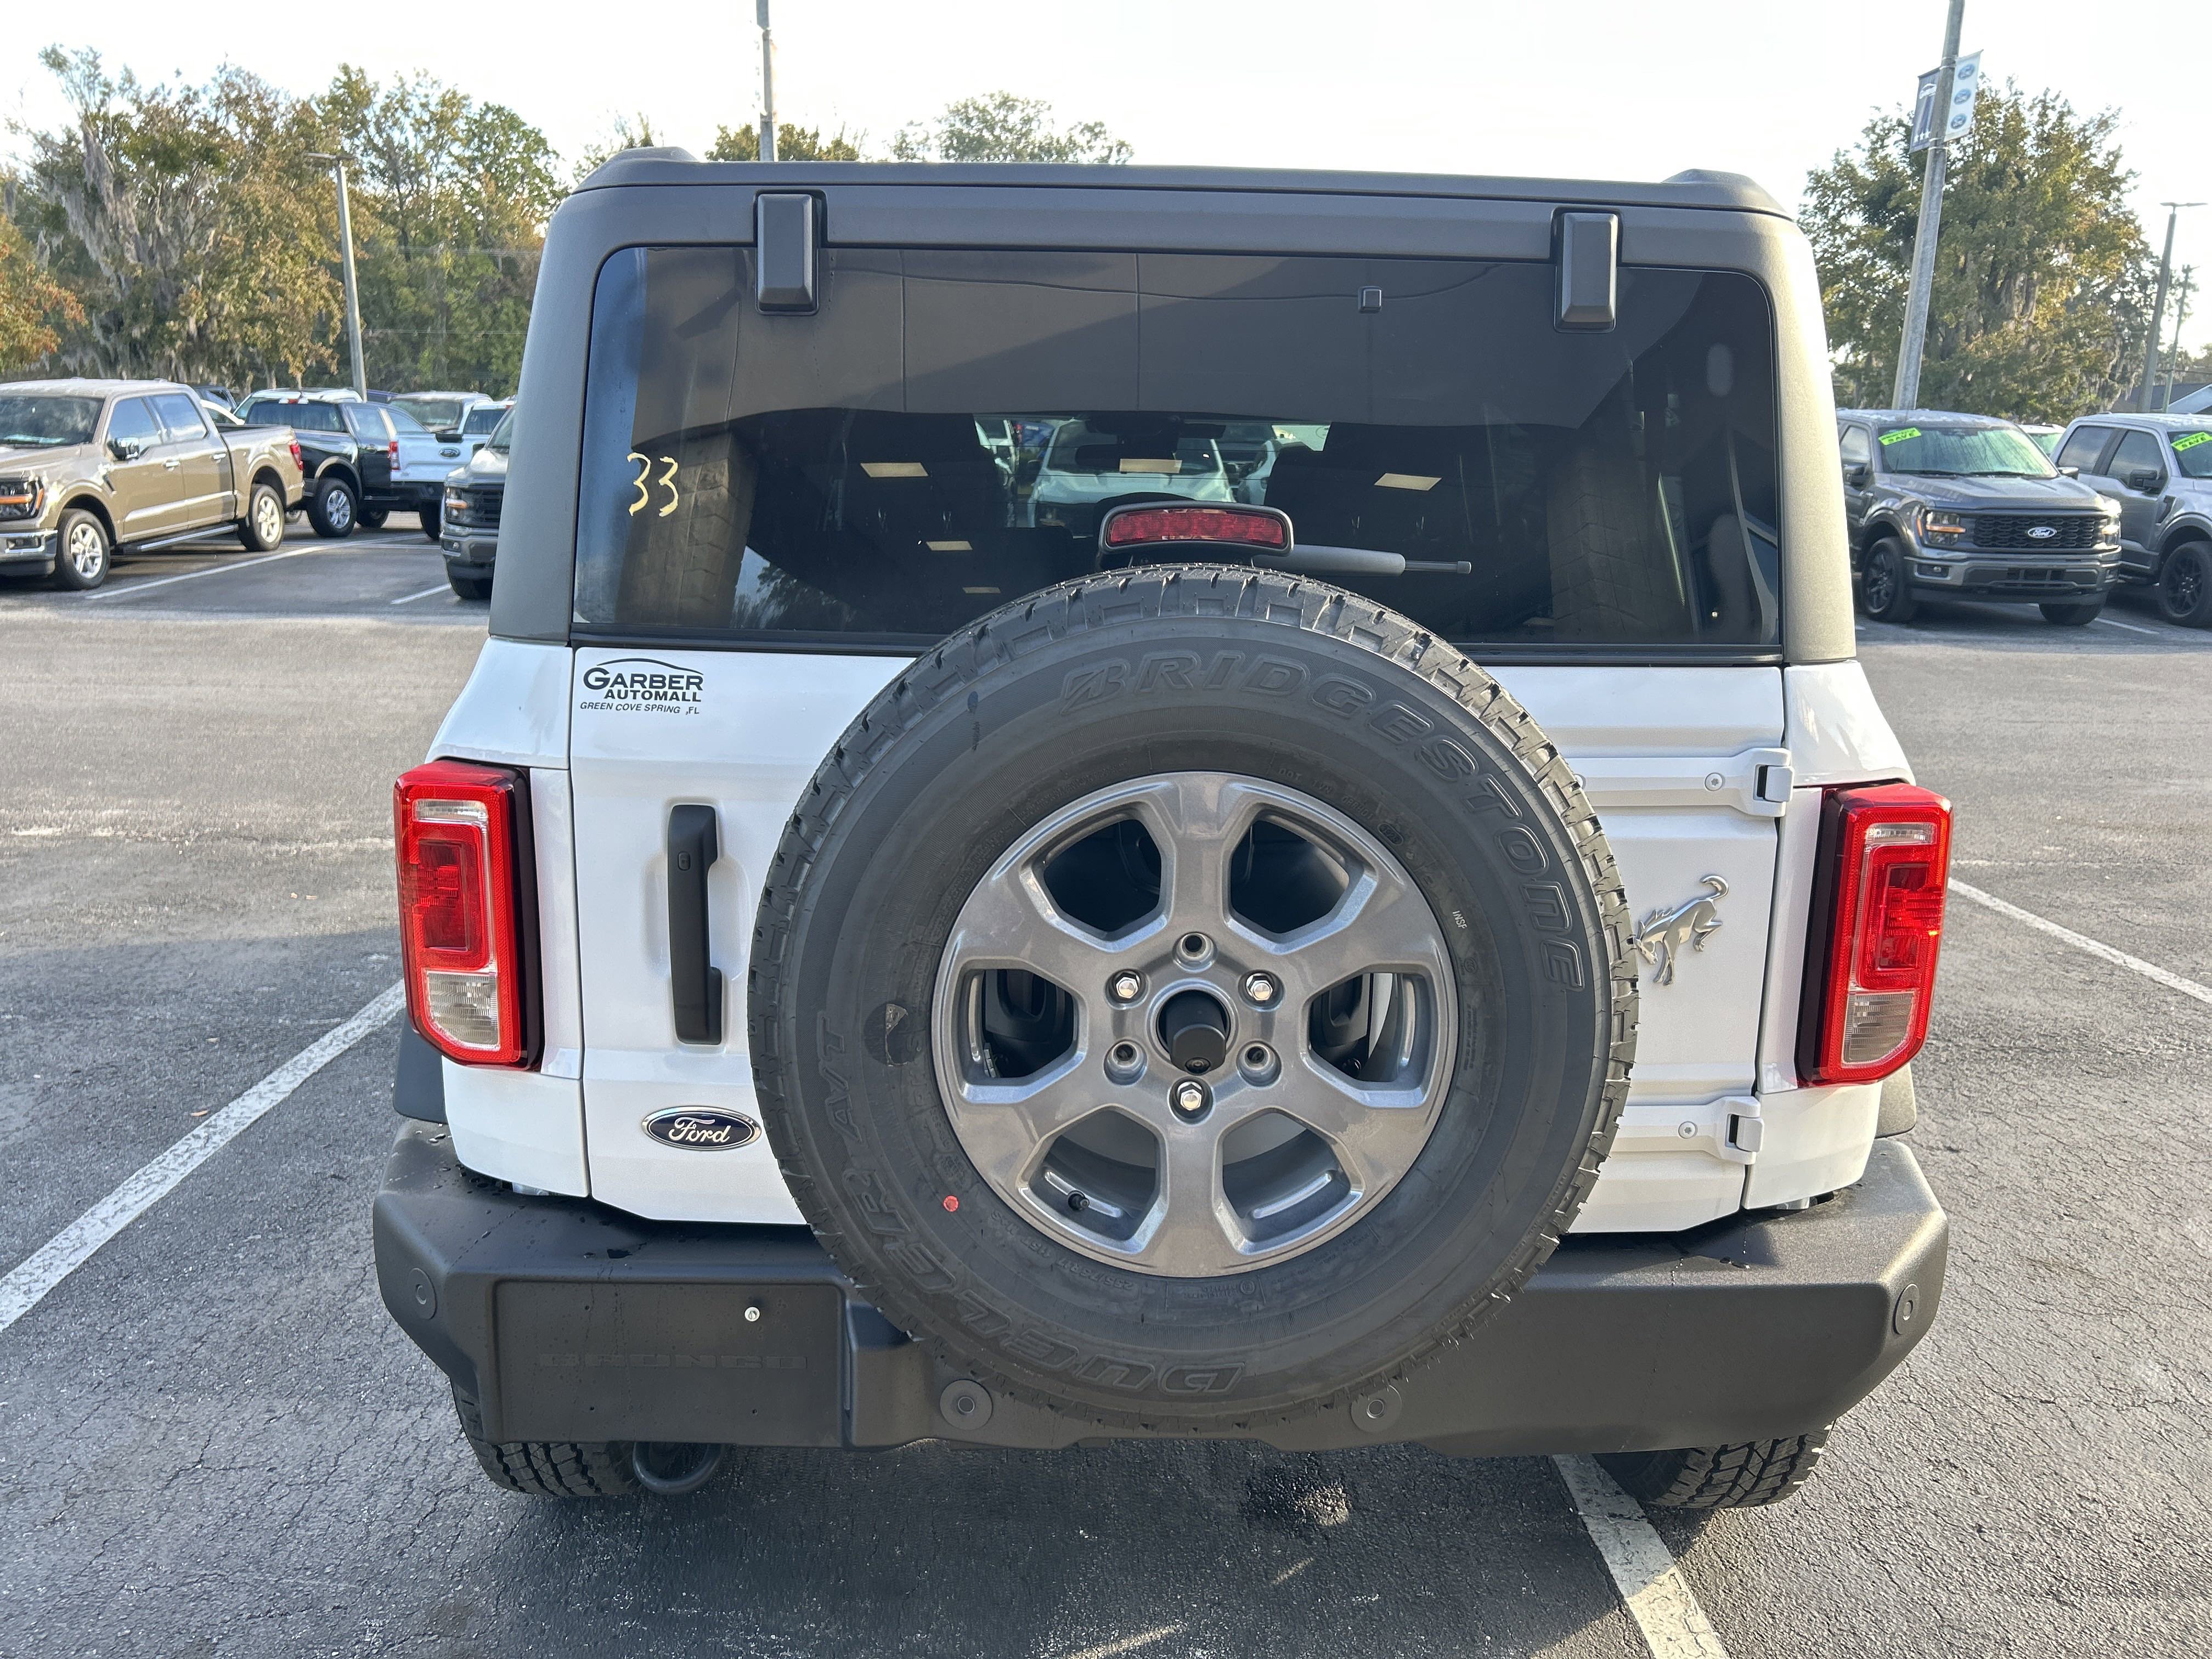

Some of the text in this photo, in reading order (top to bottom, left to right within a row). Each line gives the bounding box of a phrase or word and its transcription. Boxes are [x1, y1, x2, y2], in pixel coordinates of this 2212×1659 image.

[627, 452, 679, 517] 33
[583, 667, 703, 691] GARBER
[604, 689, 701, 702] AUTOMALL
[580, 702, 613, 710] GREEN
[616, 703, 642, 712] COVE
[644, 704, 680, 714] SPRING
[1278, 766, 1302, 781] DOT
[1059, 649, 1584, 991] BRIDGESTONE
[668, 1116, 731, 1143] Ford
[844, 1171, 1244, 1395] DUELER
[540, 1354, 808, 1369] BRONCO
